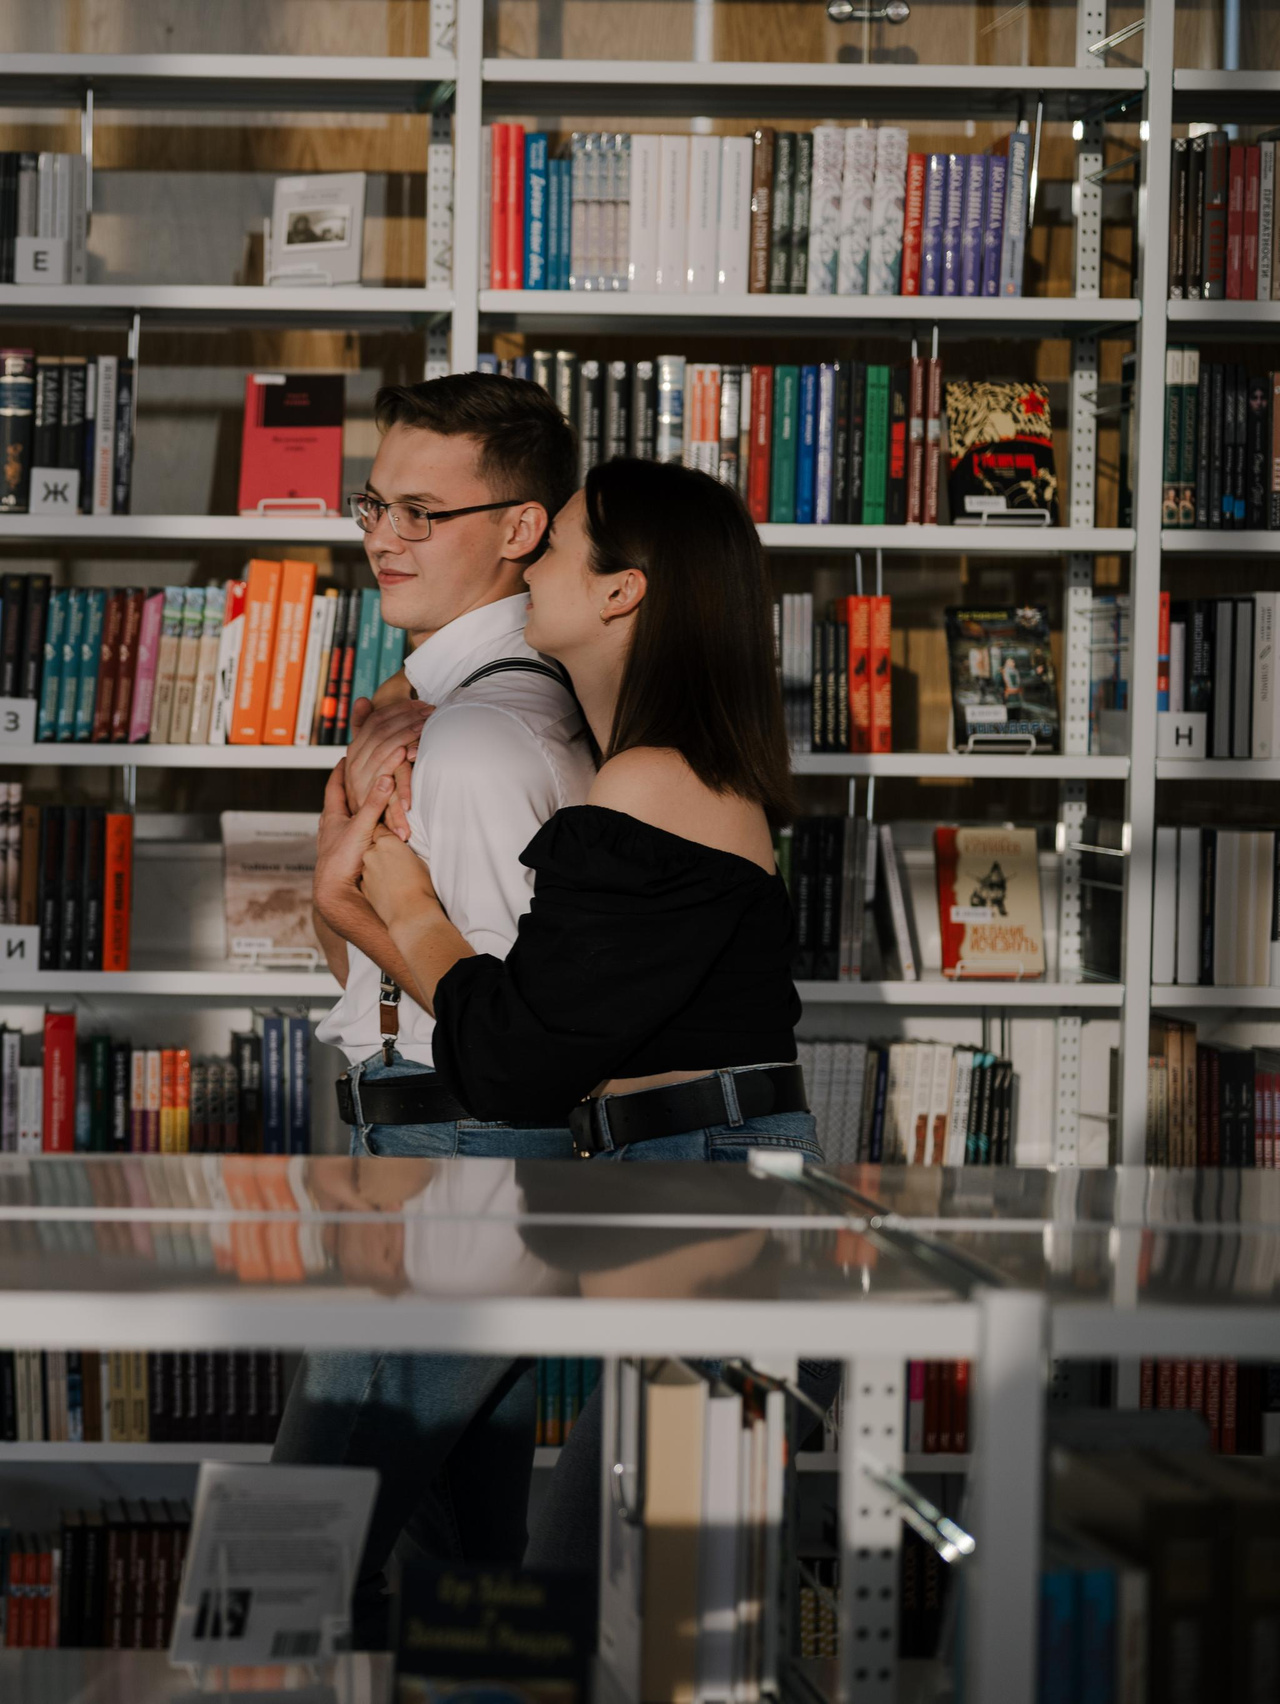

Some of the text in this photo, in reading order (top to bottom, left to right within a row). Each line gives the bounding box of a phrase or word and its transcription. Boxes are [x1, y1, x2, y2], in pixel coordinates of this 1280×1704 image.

[32, 250, 49, 272] Е
[41, 482, 70, 505] Ж
[1175, 725, 1193, 748] Н
[5, 939, 26, 960] И
